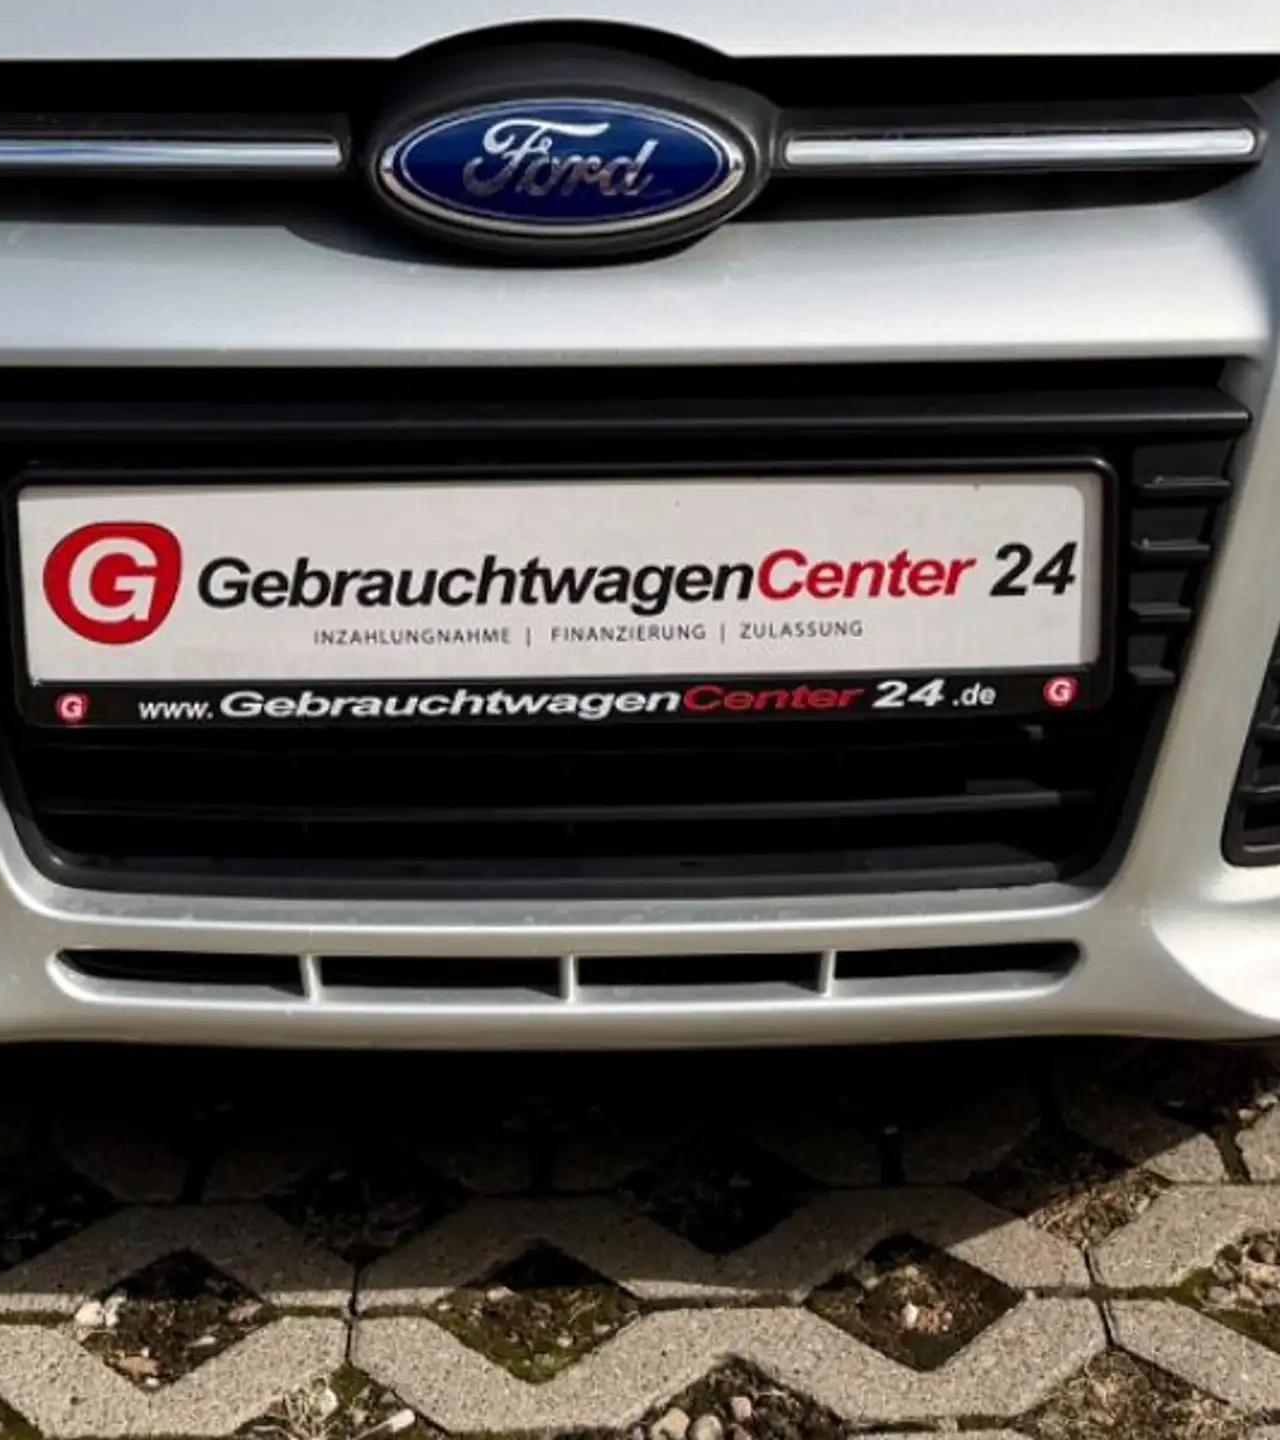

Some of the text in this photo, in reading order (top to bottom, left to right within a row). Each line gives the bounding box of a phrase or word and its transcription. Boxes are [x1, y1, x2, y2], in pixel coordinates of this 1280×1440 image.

[462, 117, 661, 197] Ford
[197, 540, 1078, 617] GebrauchtwagenCenter 24
[313, 619, 864, 647] INZAHLUNGNAHME FINANZIERUNG ZULASSUNG
